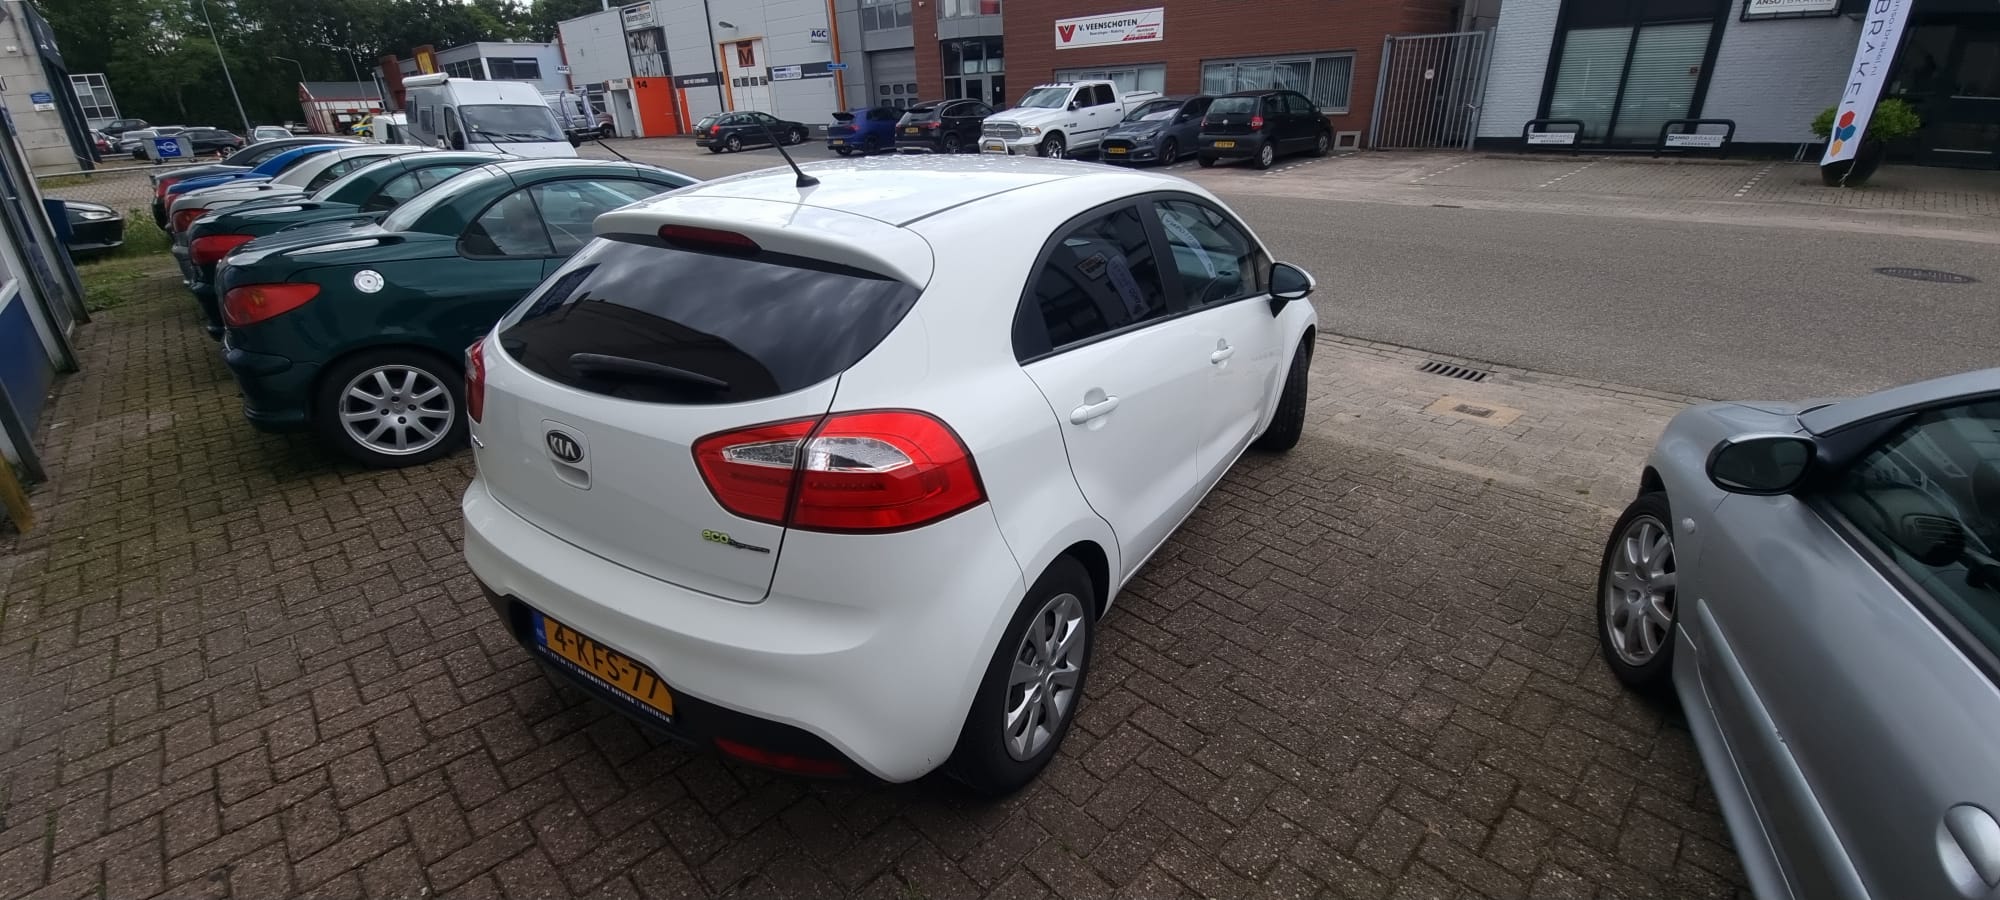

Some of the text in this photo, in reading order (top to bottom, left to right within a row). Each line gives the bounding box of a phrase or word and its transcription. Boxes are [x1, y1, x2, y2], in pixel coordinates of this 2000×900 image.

[1086, 18, 1138, 31] VEENSCHOTEN
[811, 30, 827, 38] AGC
[637, 80, 648, 88] 14
[550, 434, 577, 459] KIA
[554, 623, 660, 700] 4-KFS-77
